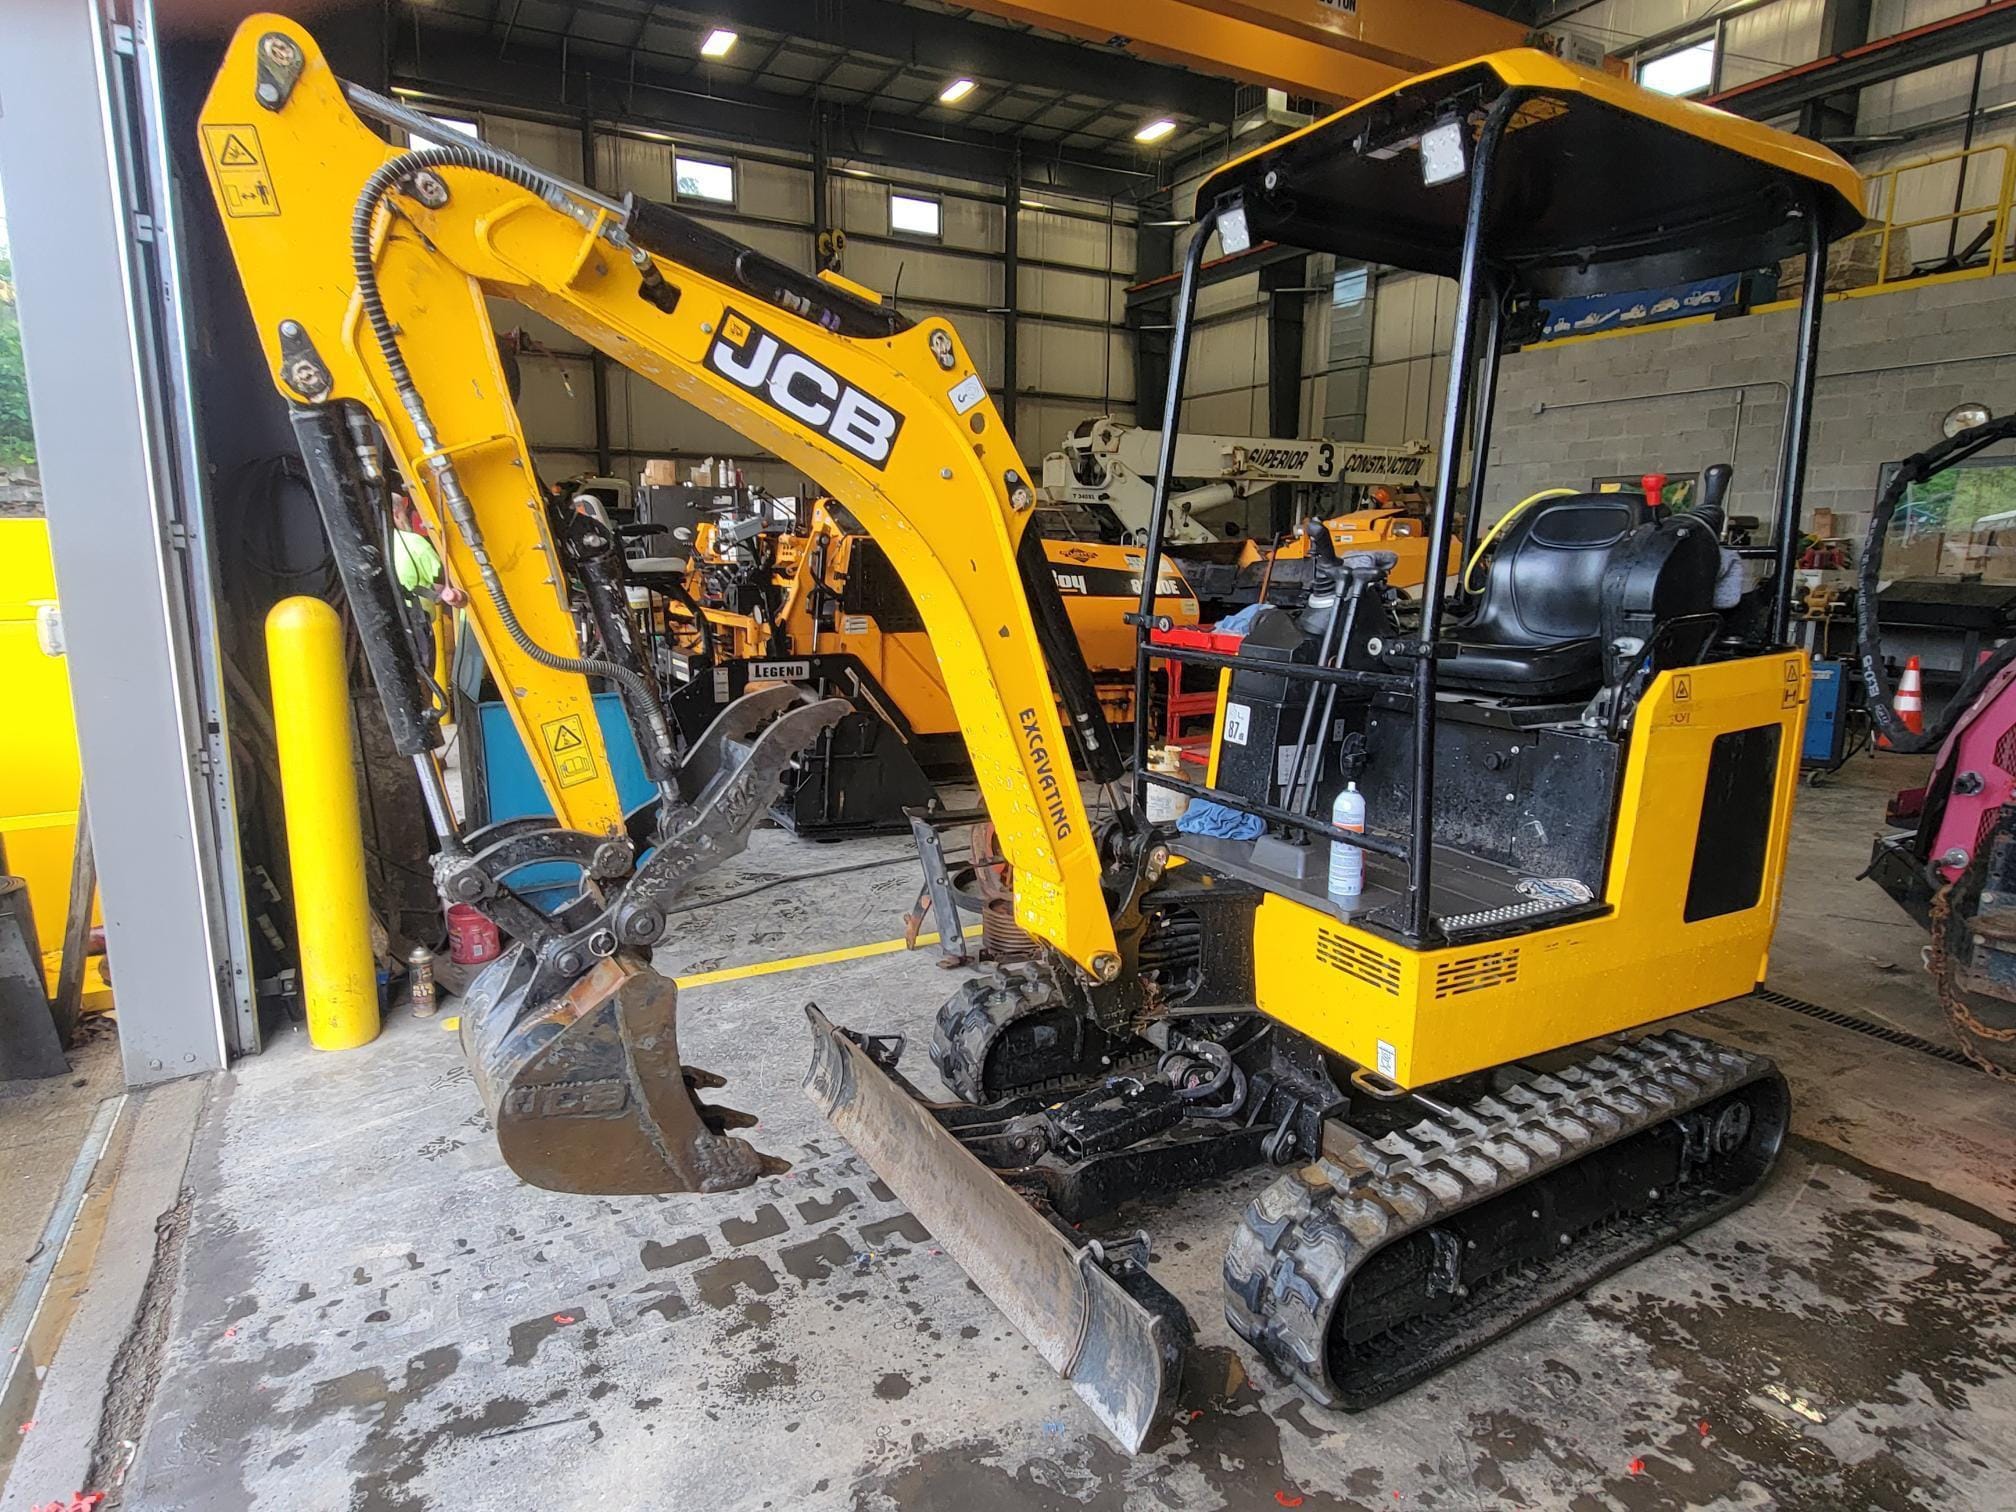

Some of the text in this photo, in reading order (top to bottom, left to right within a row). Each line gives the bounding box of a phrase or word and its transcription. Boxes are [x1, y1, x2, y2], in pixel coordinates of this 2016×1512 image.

[713, 333, 896, 461] JCB
[1248, 443, 1425, 478] SUPERIOR 3 CONSTRUCTION
[1018, 707, 1072, 841] EXCAVATING
